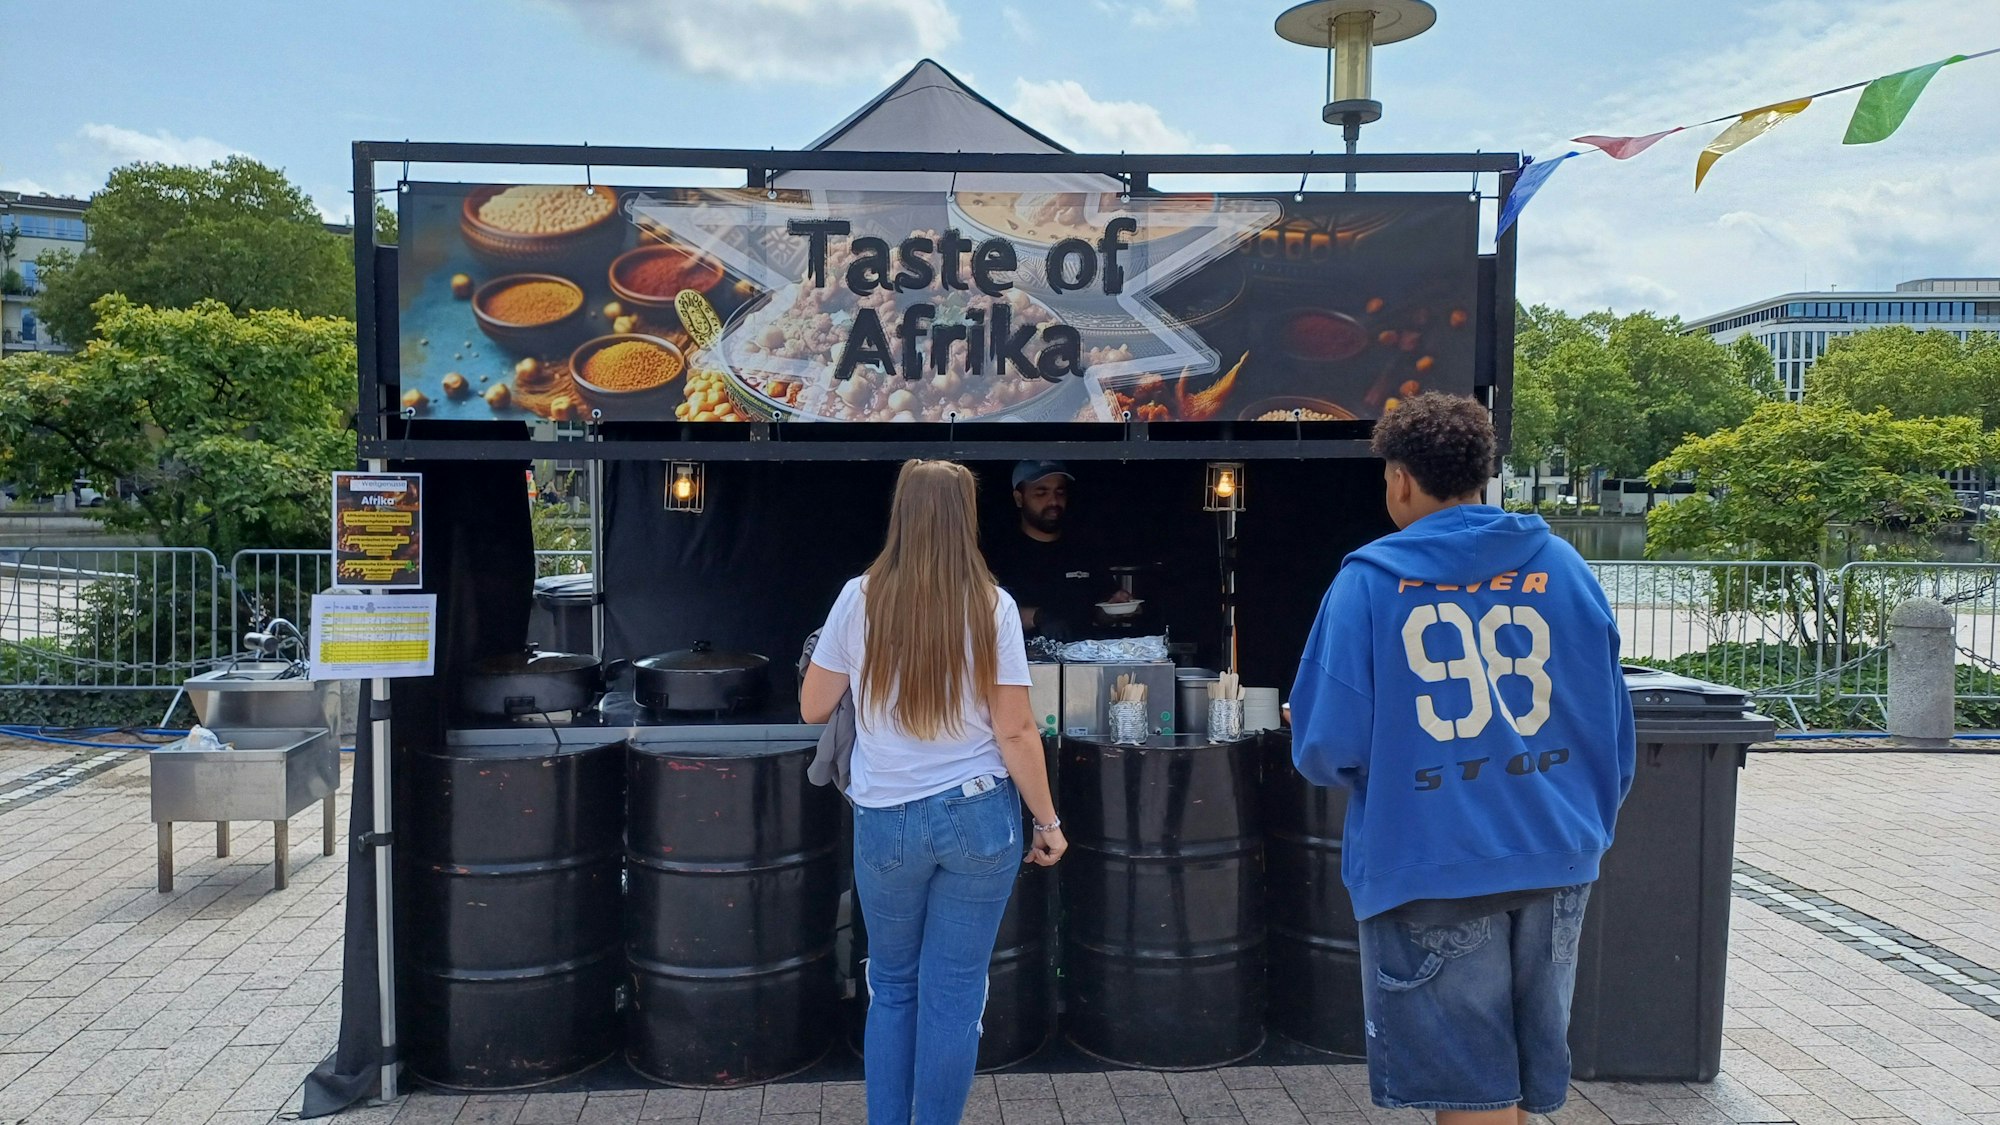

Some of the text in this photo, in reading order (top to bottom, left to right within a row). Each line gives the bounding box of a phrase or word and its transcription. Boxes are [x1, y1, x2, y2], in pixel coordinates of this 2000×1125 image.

[787, 216, 1138, 298] Taste of
[835, 303, 1085, 383] Afrika
[361, 495, 395, 505] Afrika
[1401, 602, 1552, 742] 98
[1414, 748, 1570, 791] STOP
